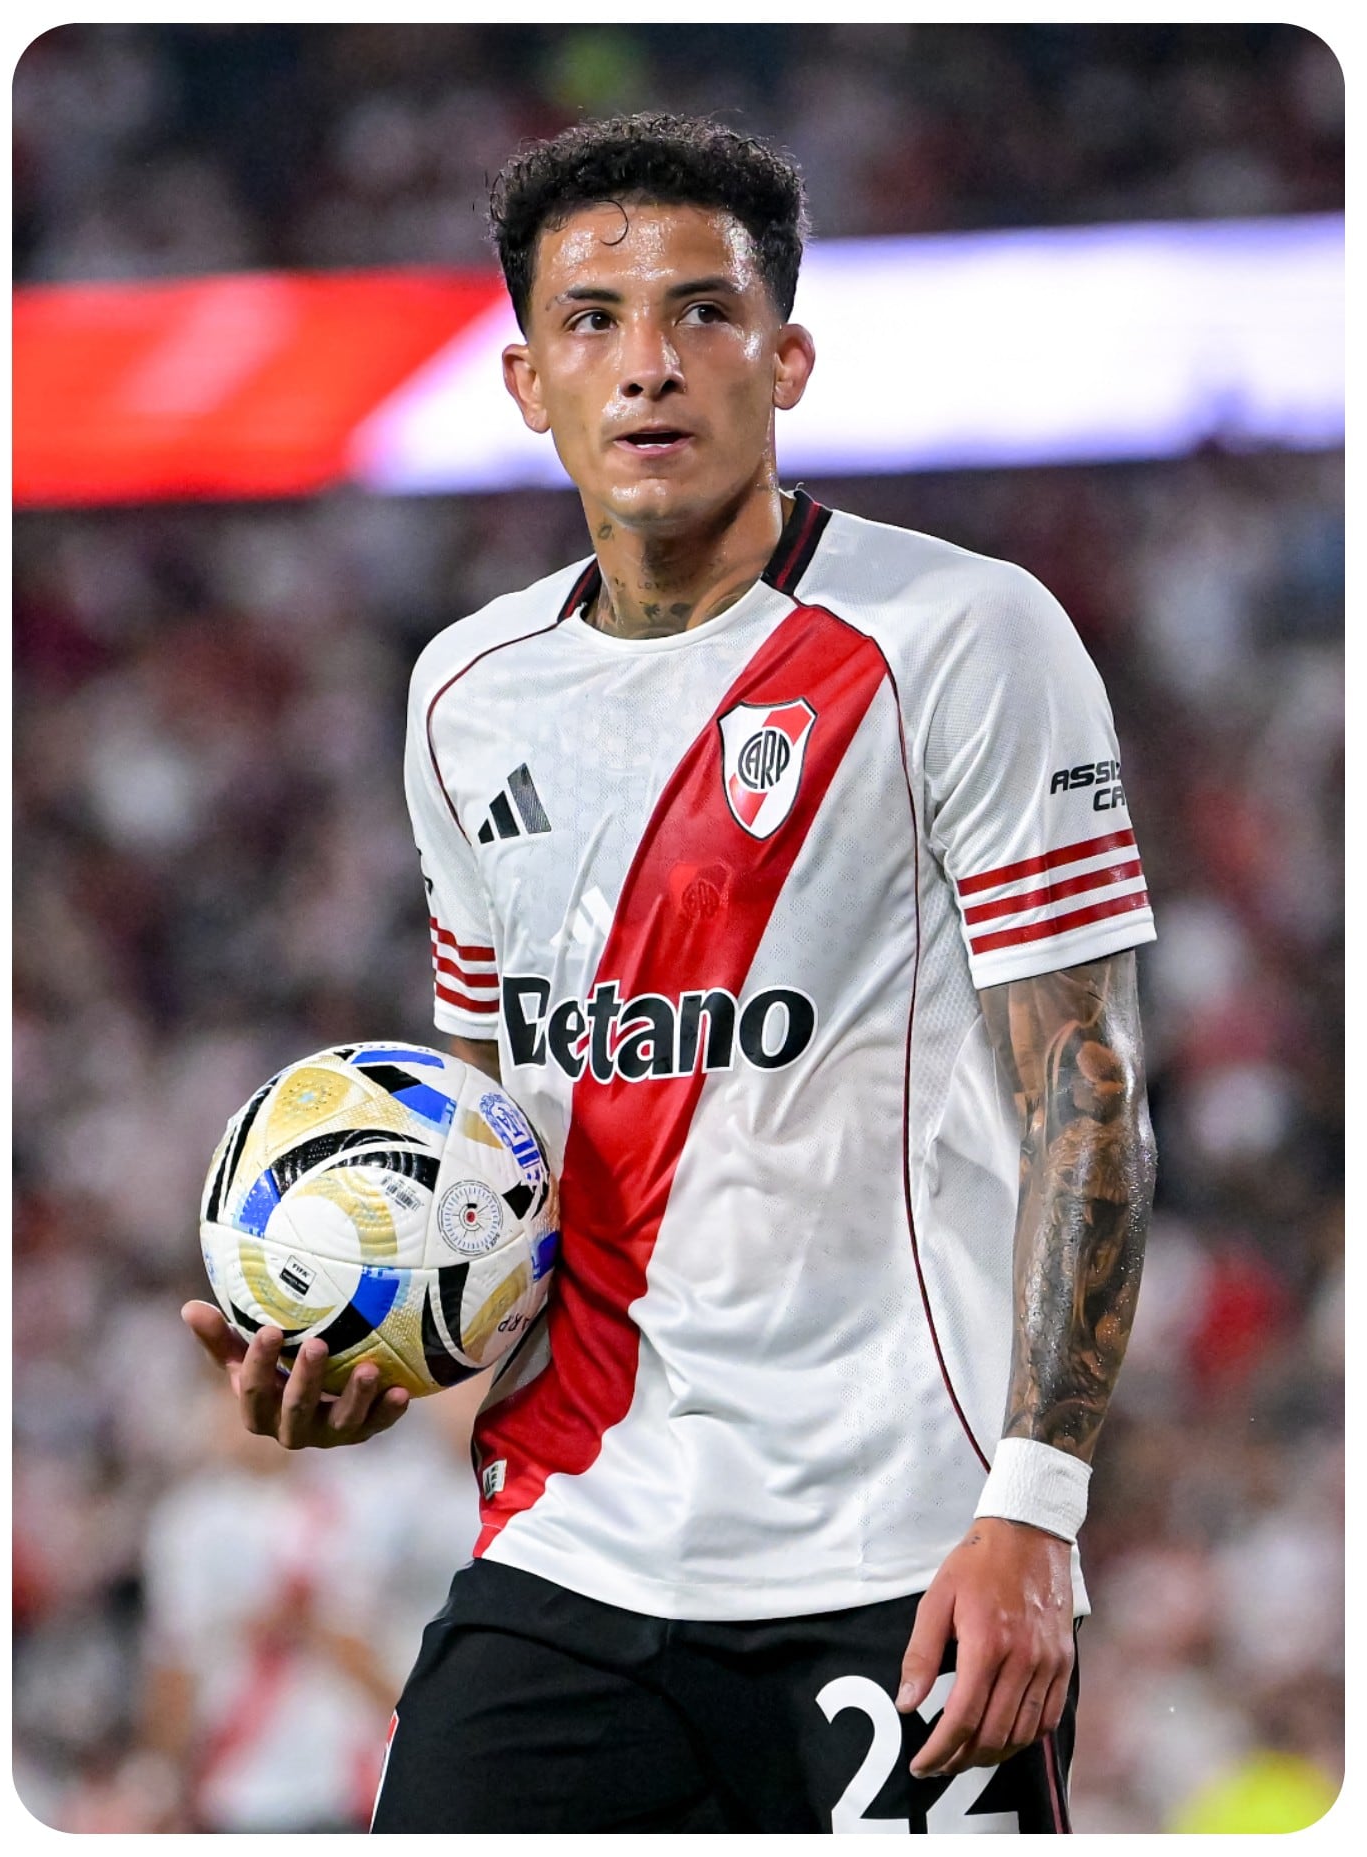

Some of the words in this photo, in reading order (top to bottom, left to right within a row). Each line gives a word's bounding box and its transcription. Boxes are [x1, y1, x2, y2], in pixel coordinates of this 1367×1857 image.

[1050, 760, 1121, 795] ASSI
[1093, 785, 1126, 812] CA
[500, 978, 817, 1082] Betano
